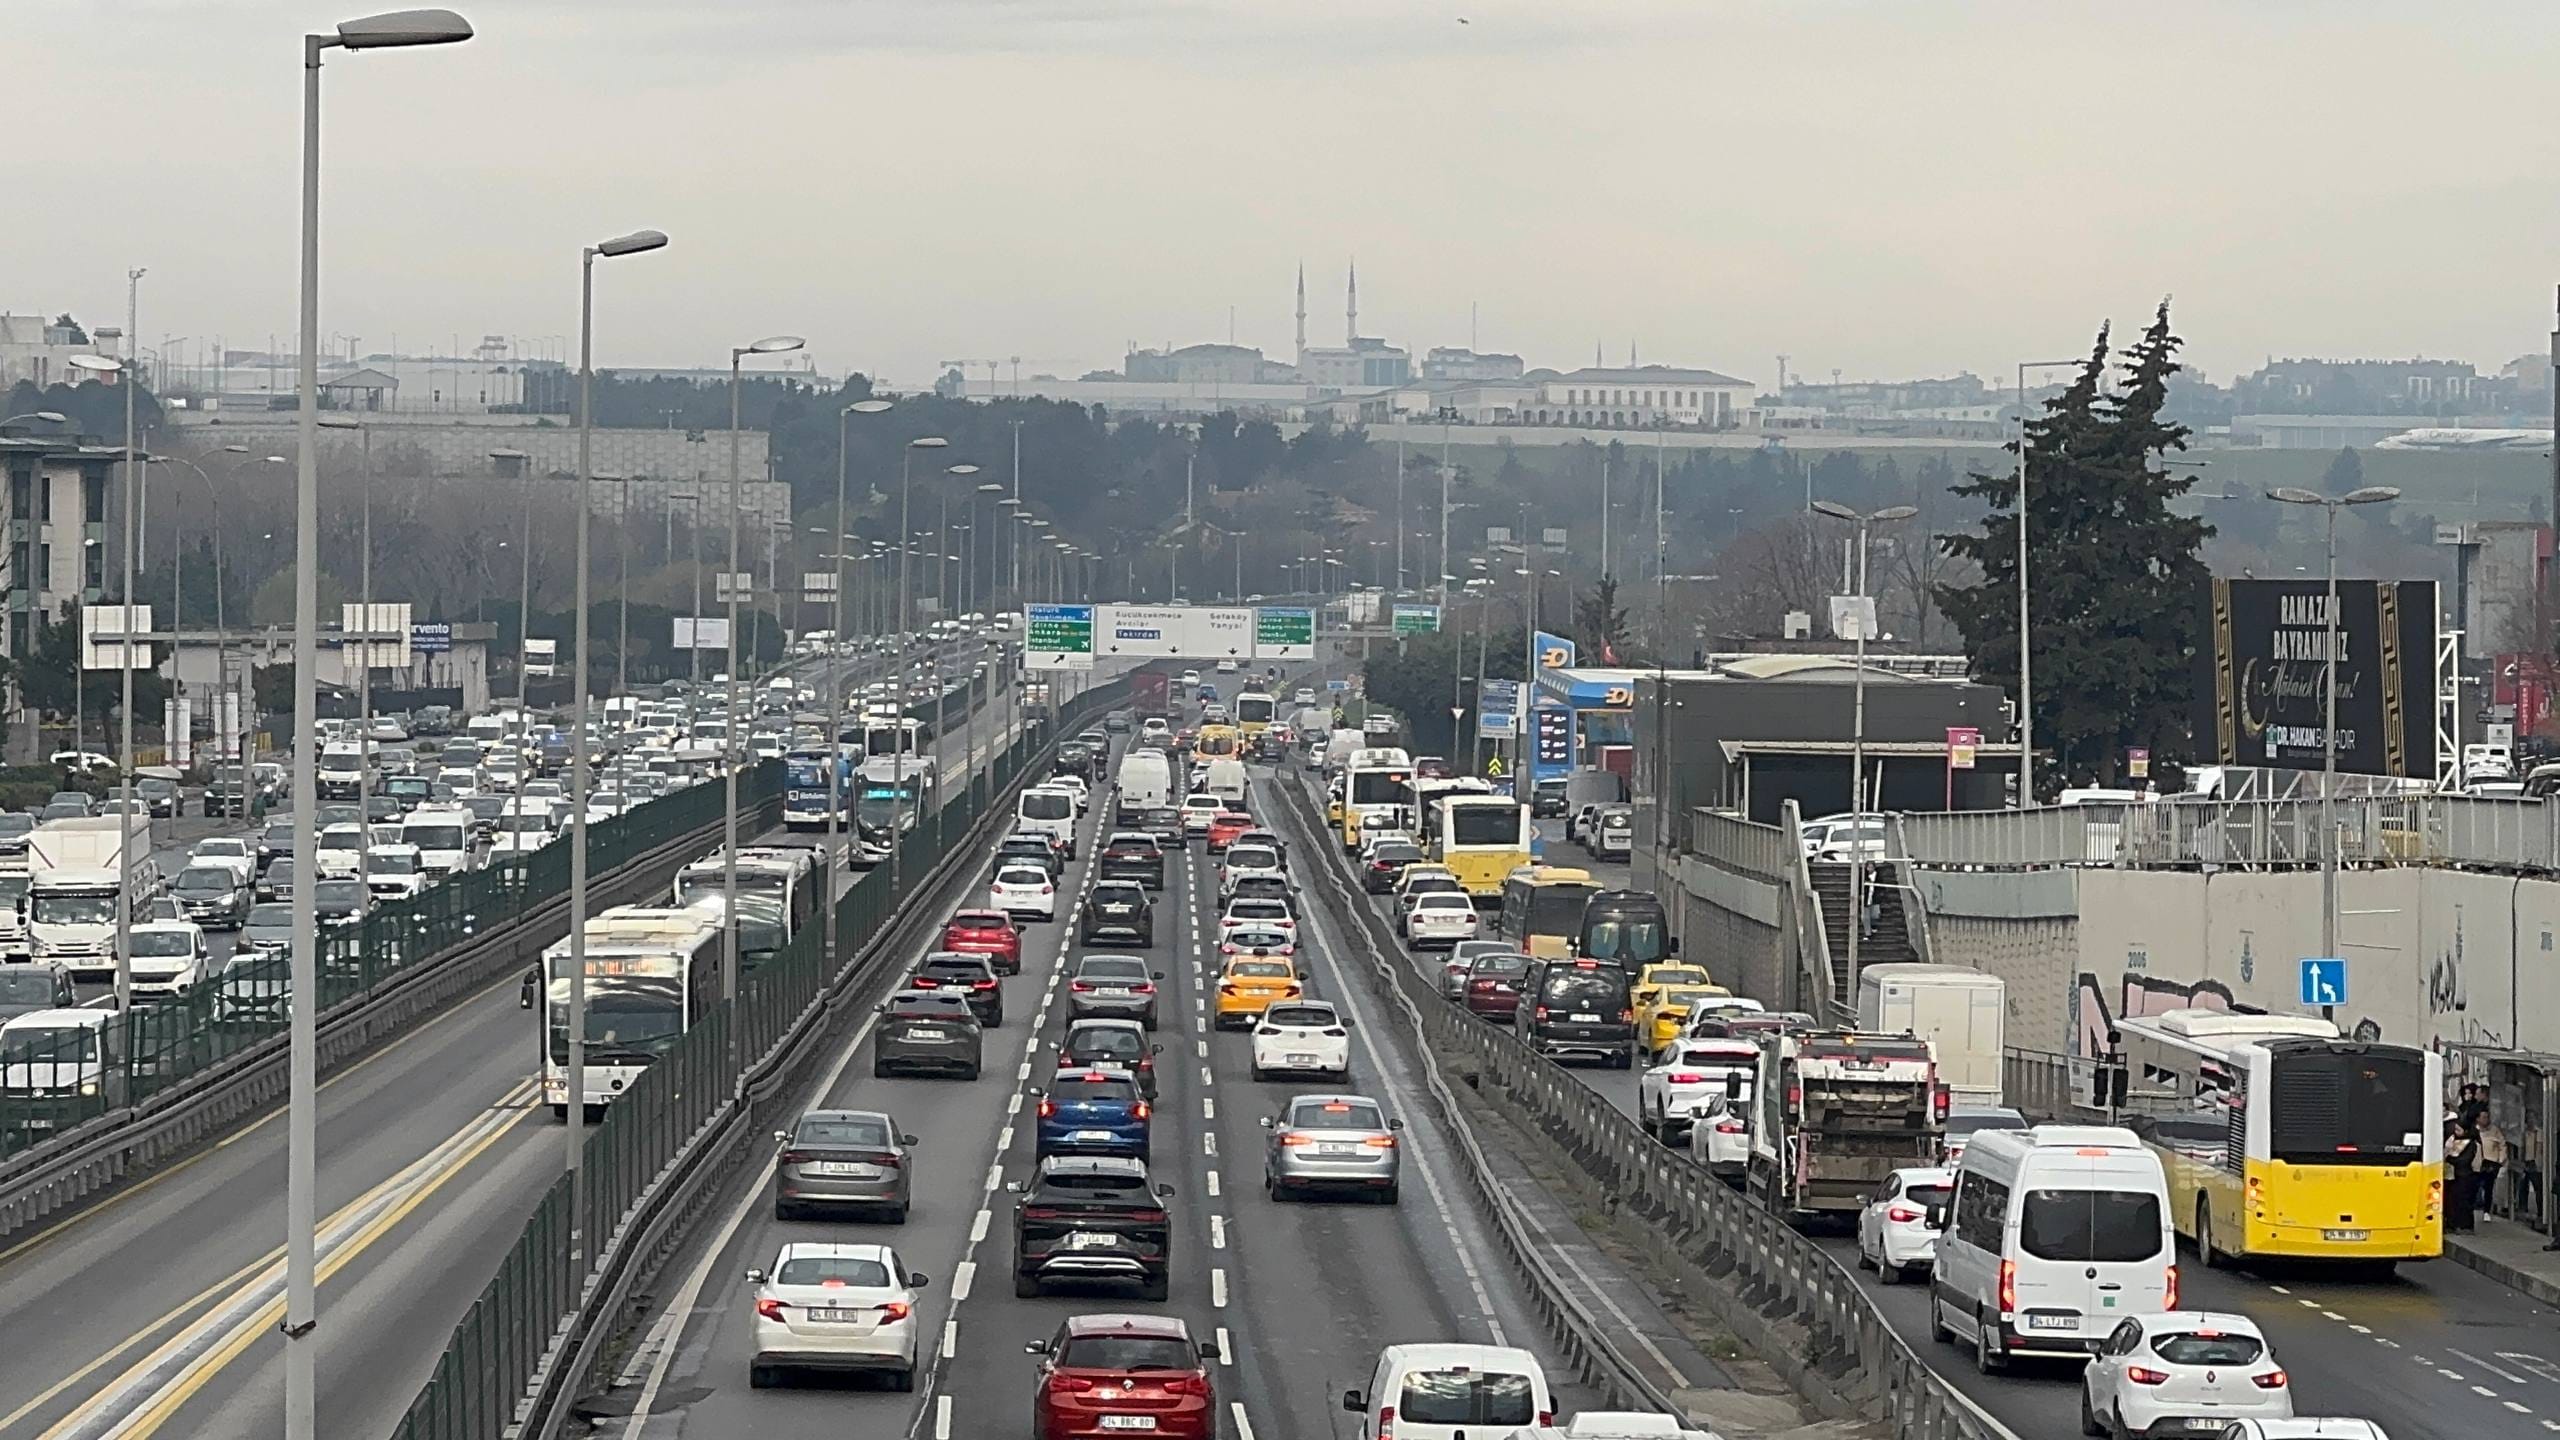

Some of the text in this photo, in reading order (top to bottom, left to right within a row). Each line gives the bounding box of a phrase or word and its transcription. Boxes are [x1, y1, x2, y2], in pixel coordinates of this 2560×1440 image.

[2281, 595, 2340, 626] RAMAZAN
[411, 623, 450, 634] rvento
[2274, 630, 2348, 661] BAYRAMIIZ
[2290, 727, 2316, 747] HAKAN
[2316, 728, 2356, 750] BAADIR
